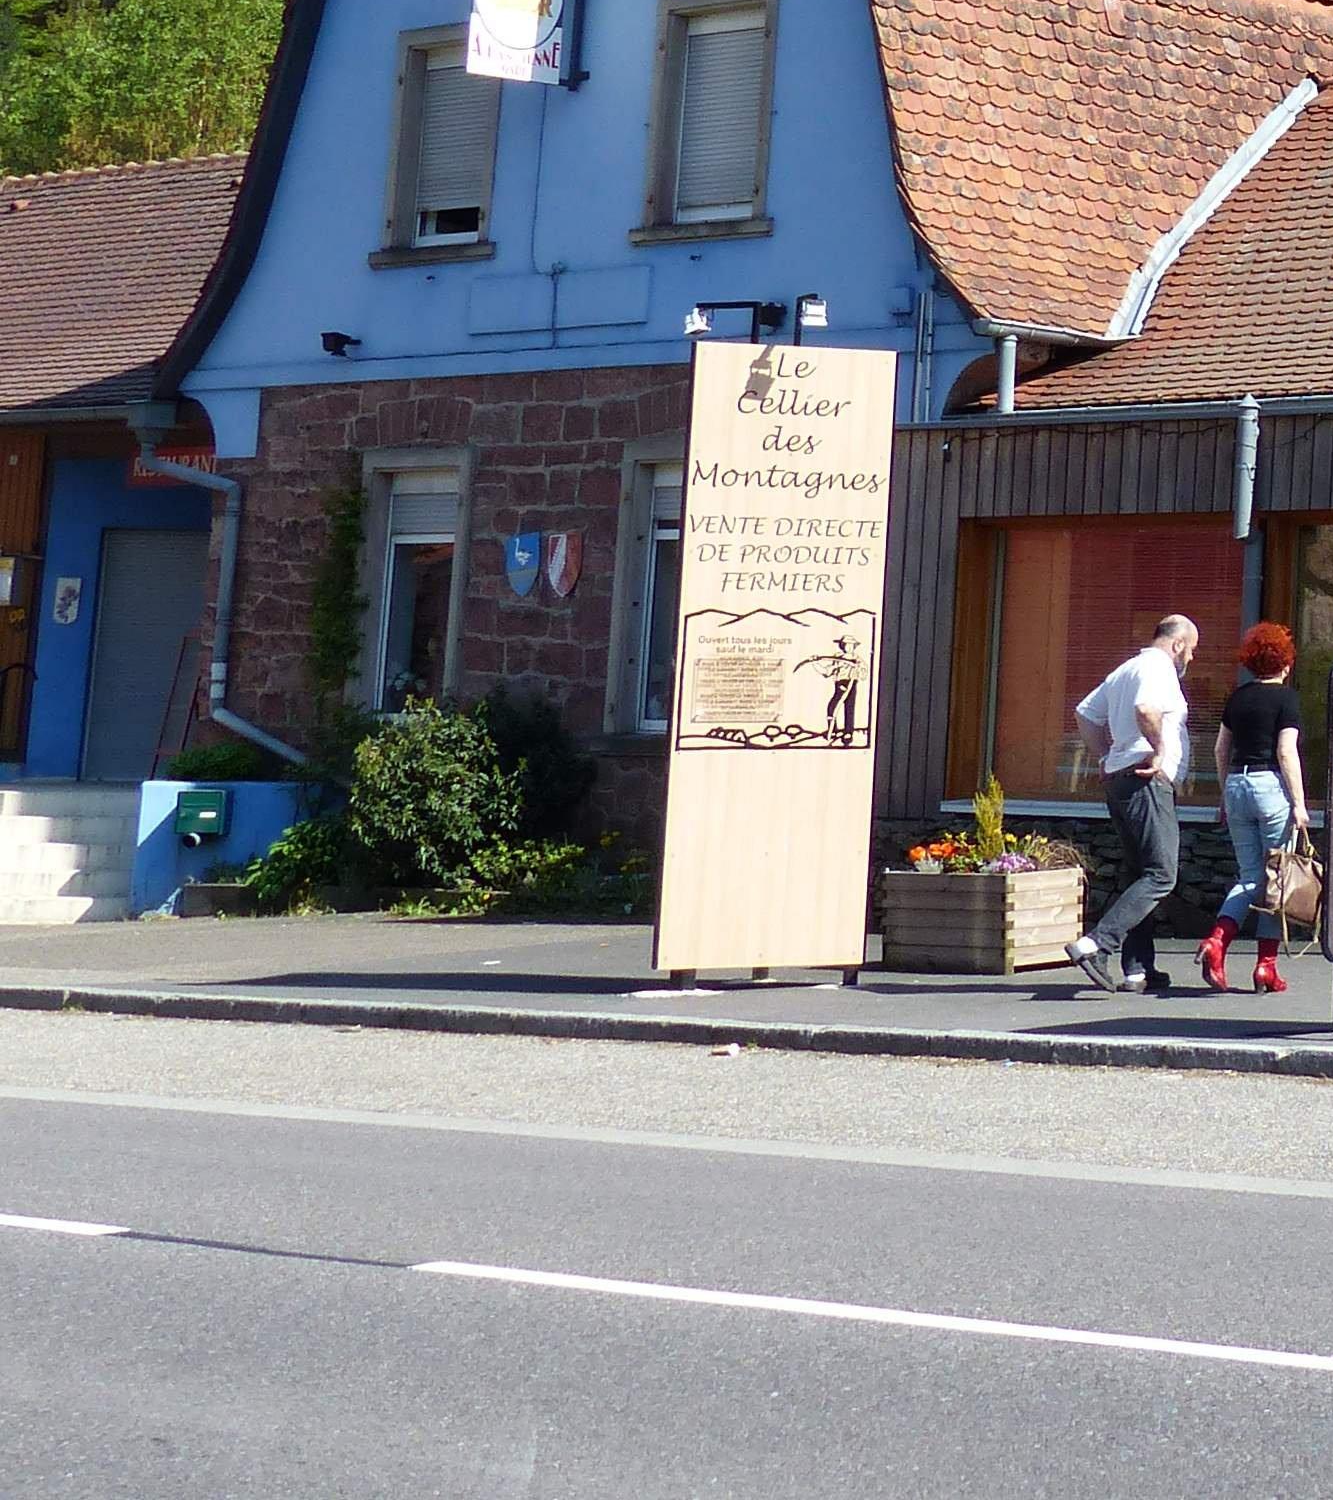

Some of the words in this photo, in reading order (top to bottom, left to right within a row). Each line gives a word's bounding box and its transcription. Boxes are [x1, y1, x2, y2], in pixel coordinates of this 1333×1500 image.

[777, 353, 816, 378] Le
[738, 389, 851, 417] Cellier
[763, 425, 822, 454] des
[692, 460, 886, 498] Montagnes
[690, 515, 766, 535] VENTE
[774, 517, 883, 538] DIRECTE
[697, 543, 733, 562] DE
[740, 544, 871, 566] PRODUITS
[721, 571, 846, 593] FERMIERS
[698, 635, 729, 644] Ouvert
[731, 636, 752, 644] tous
[753, 636, 767, 645] les
[748, 644, 775, 653] mardi
